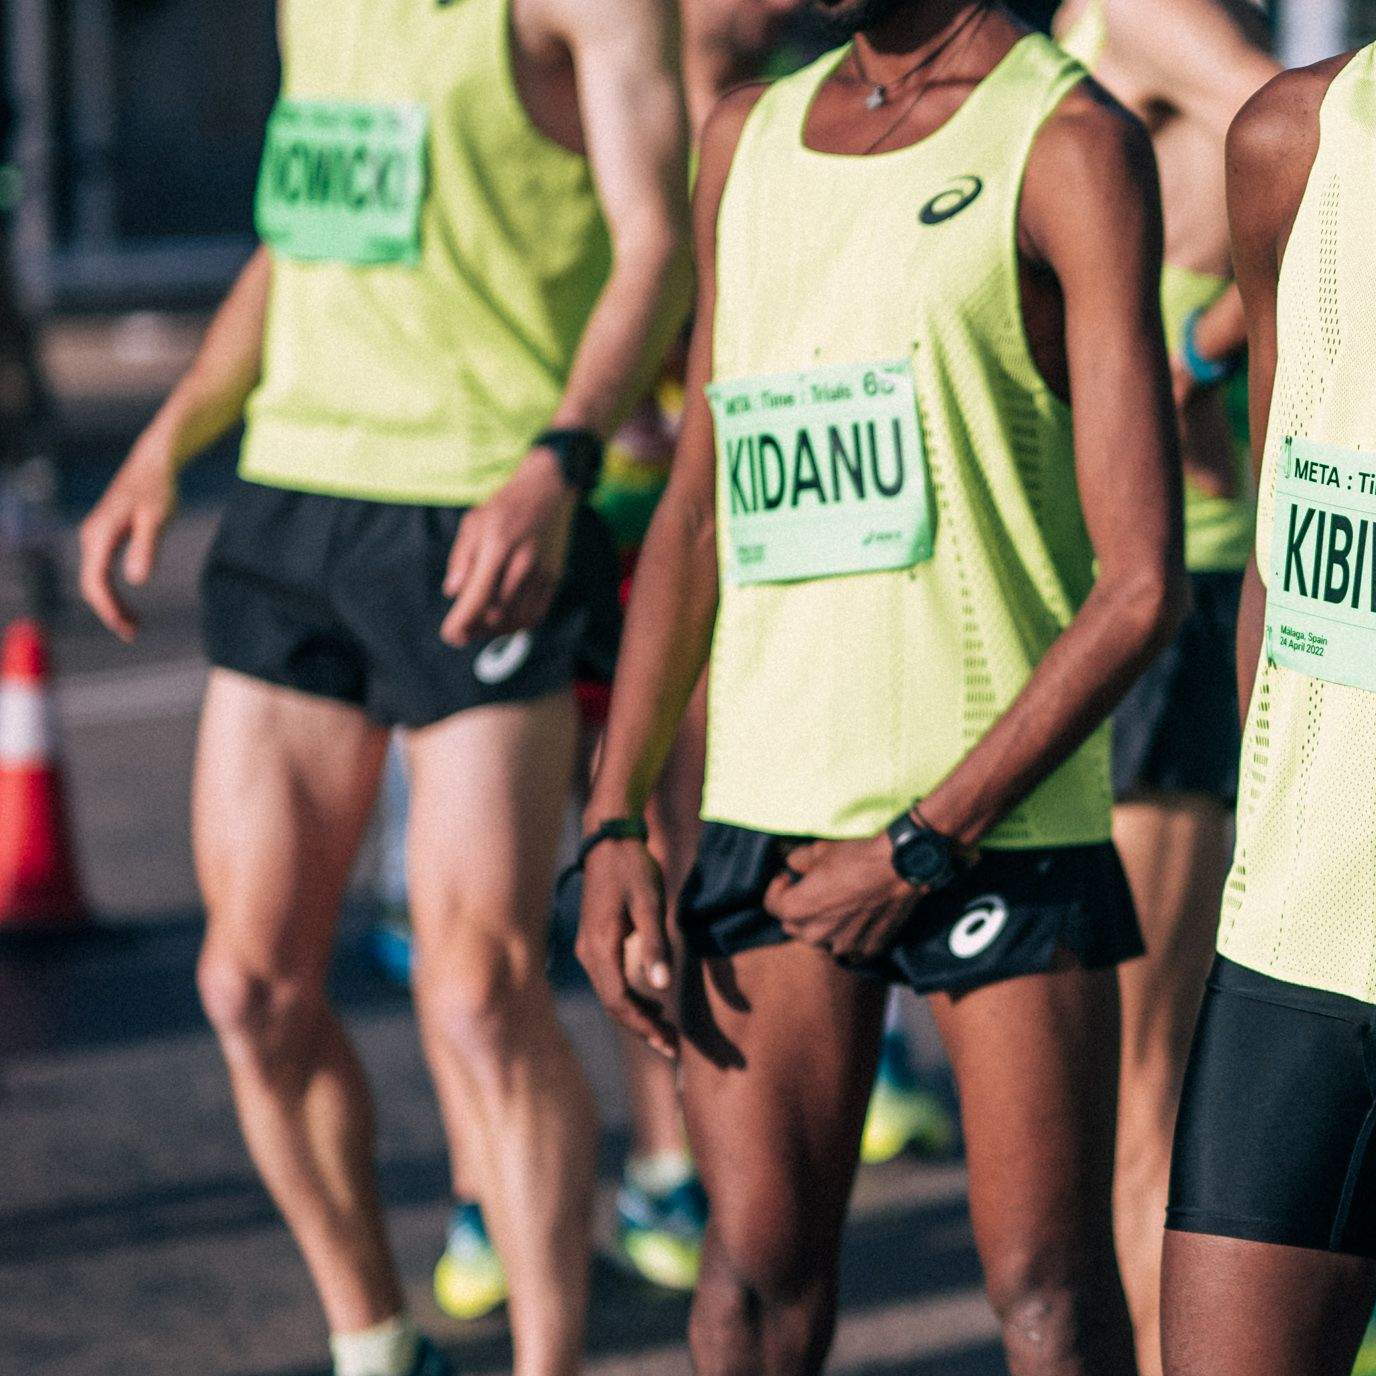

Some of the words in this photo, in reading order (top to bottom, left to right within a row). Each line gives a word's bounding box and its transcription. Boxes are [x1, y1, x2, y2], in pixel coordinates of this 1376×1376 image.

[726, 418, 906, 516] KIDANU
[1294, 458, 1341, 488] META
[1289, 639, 1305, 652] April
[1306, 644, 1324, 657] 2022
[1308, 632, 1328, 645] Spain
